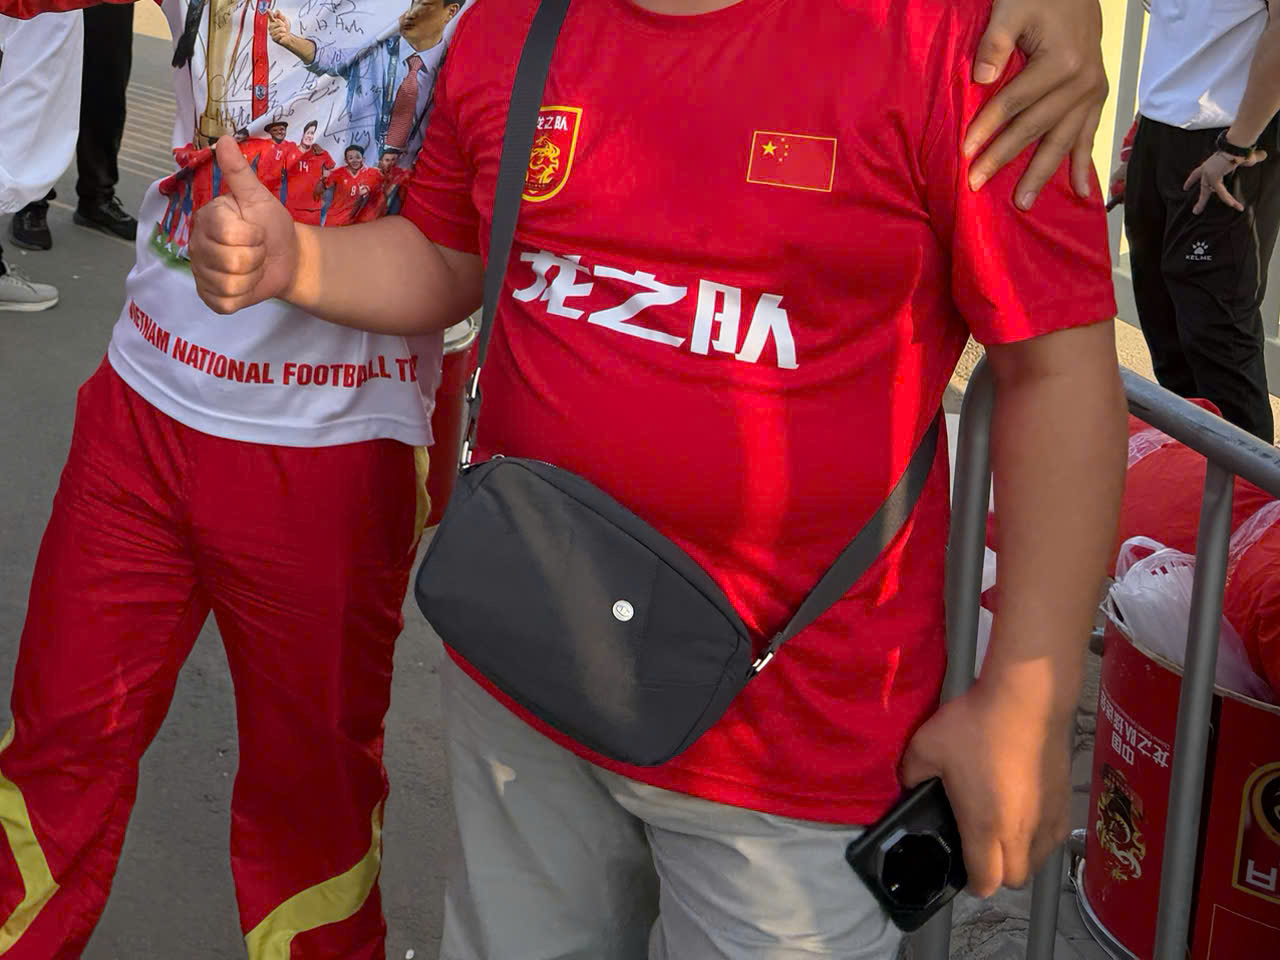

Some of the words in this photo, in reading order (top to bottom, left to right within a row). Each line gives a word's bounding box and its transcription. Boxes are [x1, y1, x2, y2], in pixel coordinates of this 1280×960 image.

[512, 250, 799, 369] 龙之队
[172, 336, 274, 385] NATIONAL
[282, 353, 392, 388] FOOTBALL
[1111, 731, 1134, 766] 中国
